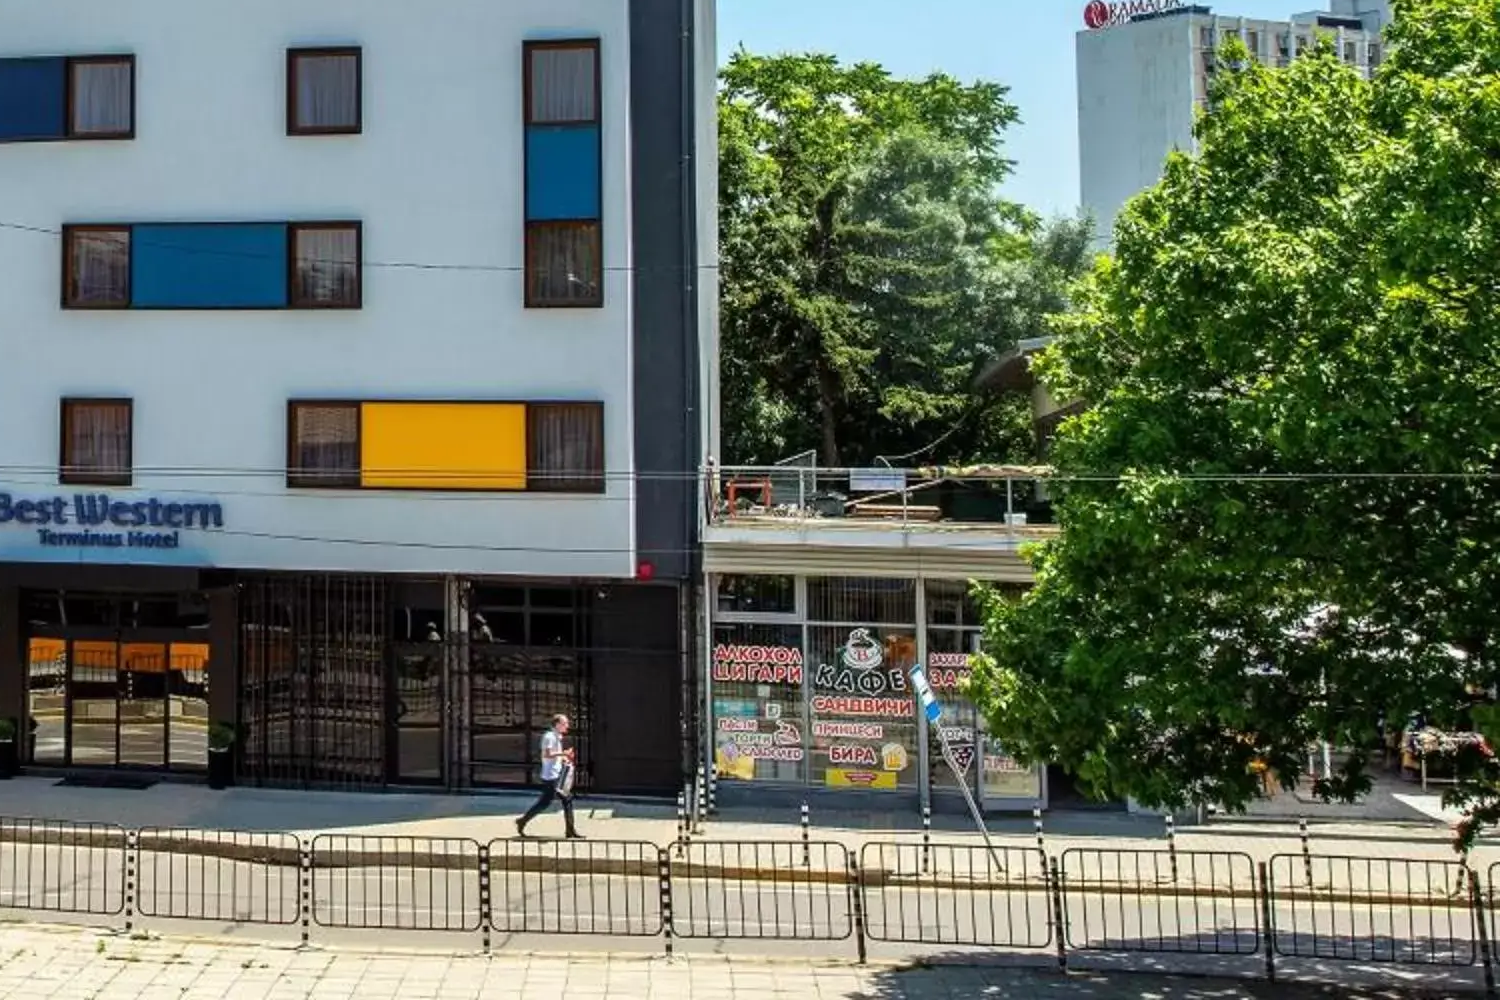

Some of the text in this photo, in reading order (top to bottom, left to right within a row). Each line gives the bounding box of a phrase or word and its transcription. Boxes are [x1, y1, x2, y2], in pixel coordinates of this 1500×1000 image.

[73, 493, 224, 529] Western
[37, 528, 179, 549] Terminus Hotel
[713, 644, 802, 664] АЛКОХОЛ
[713, 662, 802, 684] ЦИГАРИ
[815, 663, 907, 696] КАФЕ
[811, 696, 915, 716] САНДВИЧИ
[830, 746, 876, 765] БИРА
